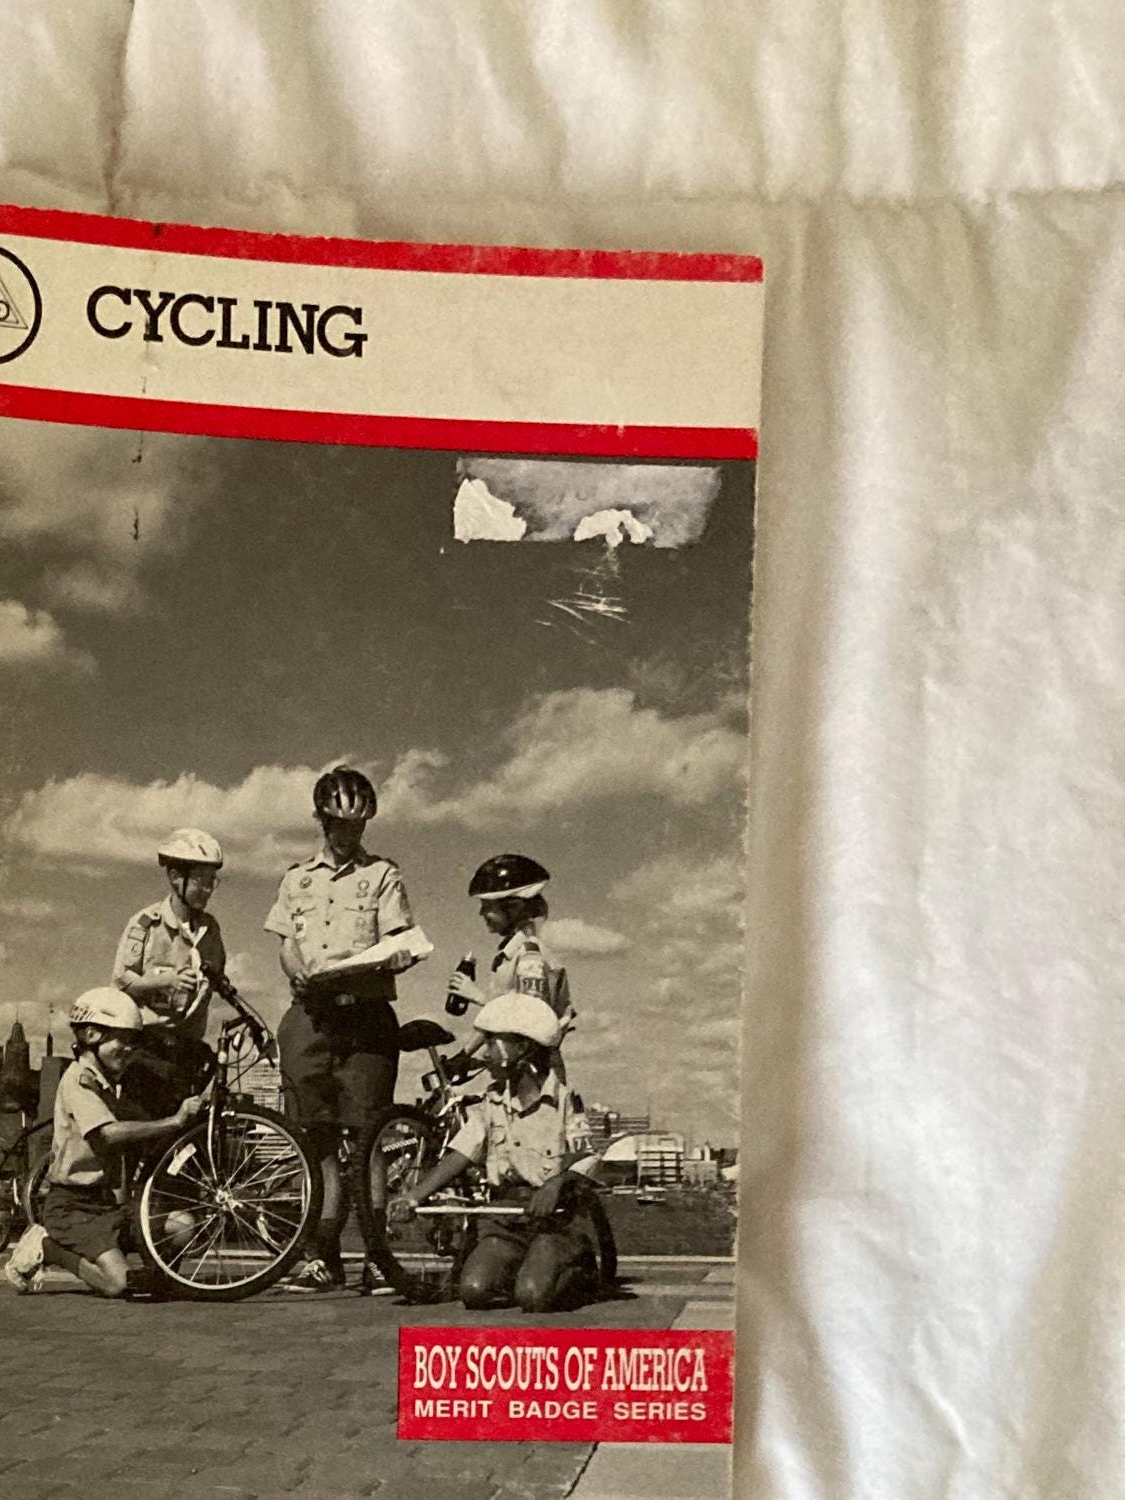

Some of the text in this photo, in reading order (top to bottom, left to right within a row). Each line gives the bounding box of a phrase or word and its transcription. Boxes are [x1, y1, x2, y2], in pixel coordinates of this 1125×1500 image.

[85, 284, 369, 358] CYCLING
[413, 1345, 708, 1393] BOY SCOUTS OF AMERICA
[414, 1399, 707, 1421] MERIT BADGE SERIES
